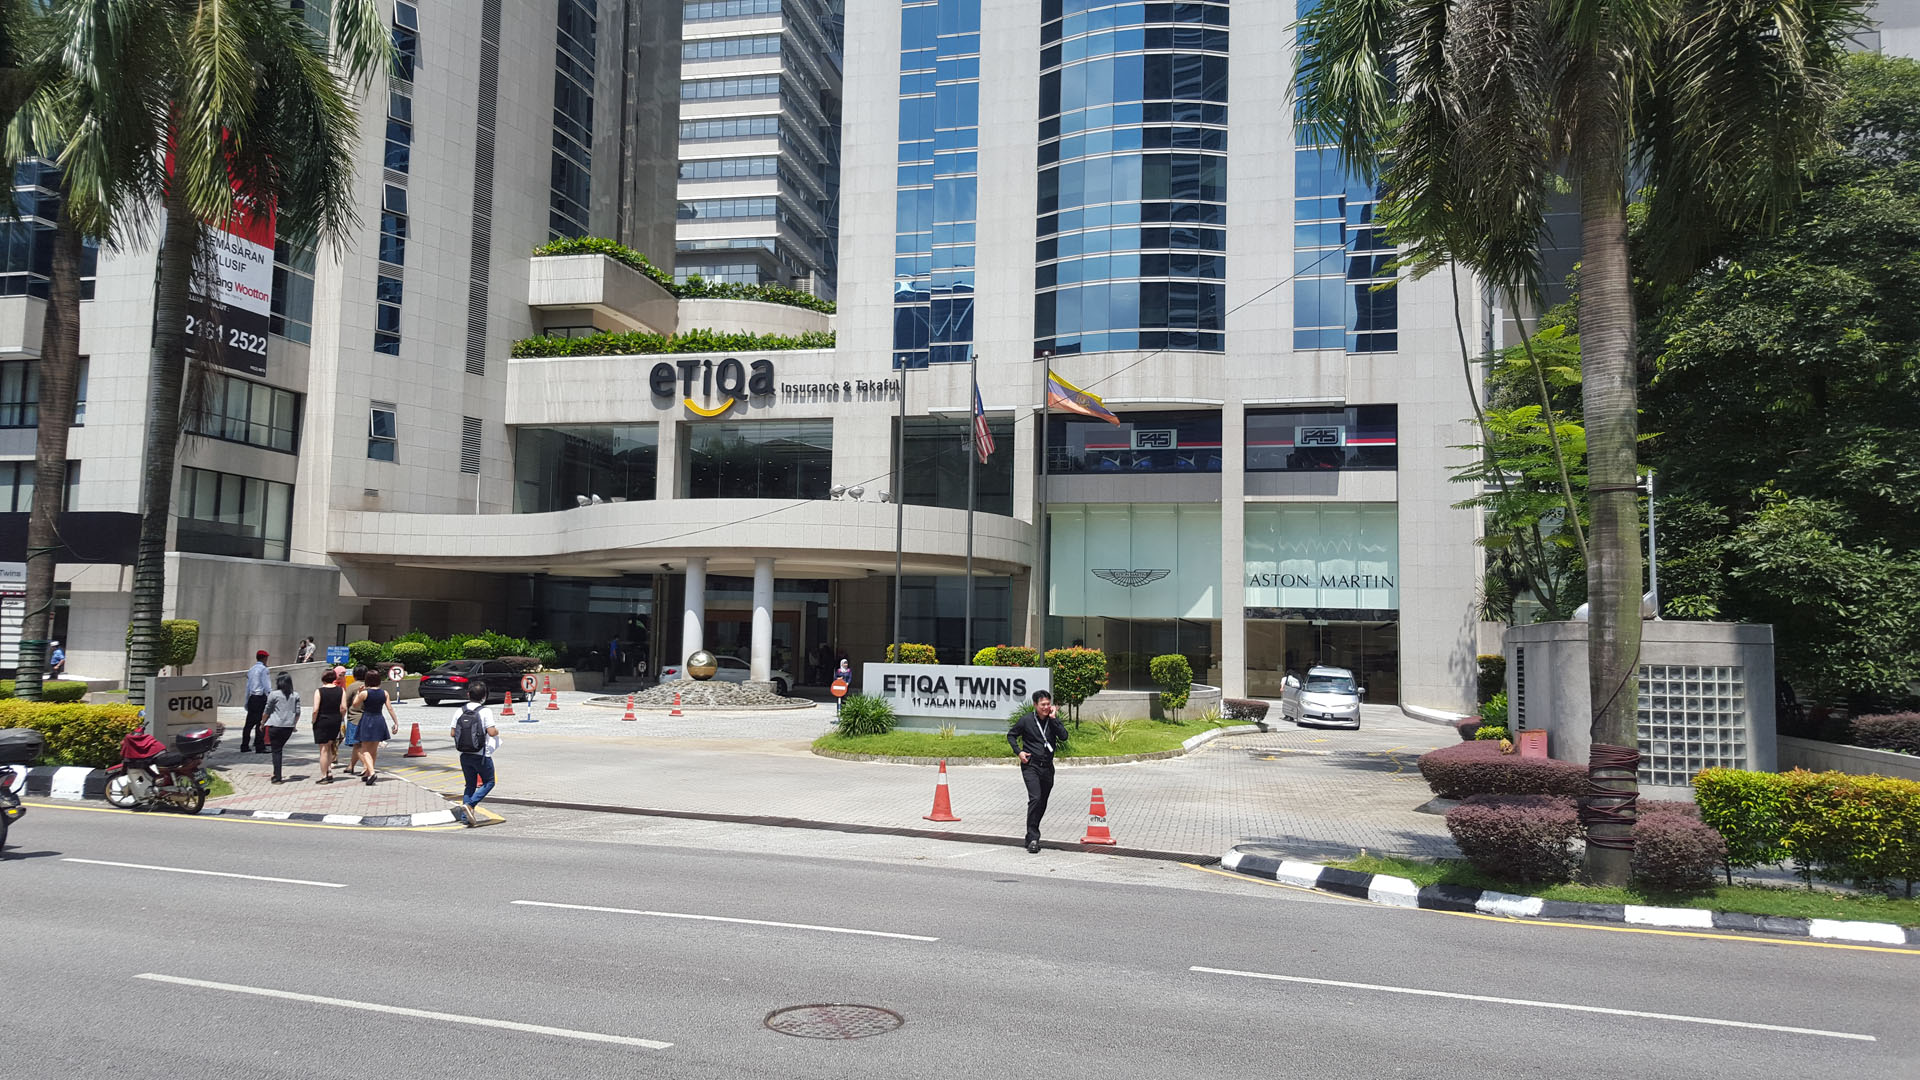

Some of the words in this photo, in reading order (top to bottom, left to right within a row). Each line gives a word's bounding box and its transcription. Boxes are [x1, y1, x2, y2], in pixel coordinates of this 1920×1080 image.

[235, 281, 270, 303] Wootton
[229, 328, 267, 356] 2522
[781, 382, 840, 393] Insurance
[843, 380, 852, 392] &
[855, 378, 901, 392] Takaful
[1137, 430, 1171, 448] F45
[1301, 427, 1338, 445] F45
[1250, 573, 1309, 588] ASTON
[1320, 574, 1394, 589] MARTIN
[883, 674, 949, 694] ETIQA
[955, 676, 1027, 697] TWINS
[911, 697, 921, 707] 11
[924, 697, 956, 708] JALAN
[959, 698, 997, 709] PINANG
